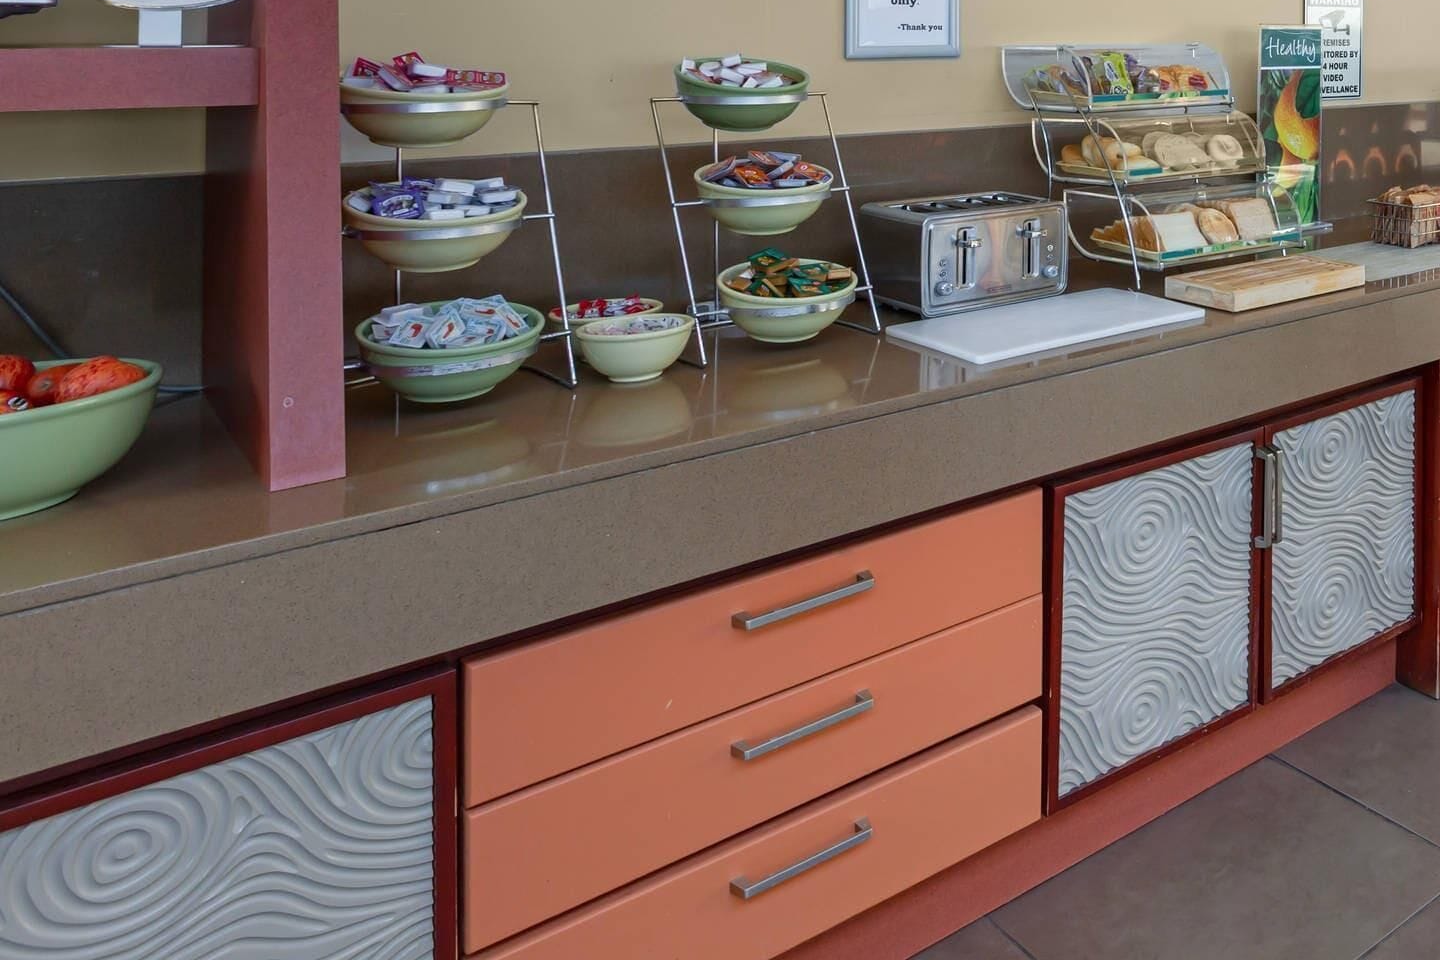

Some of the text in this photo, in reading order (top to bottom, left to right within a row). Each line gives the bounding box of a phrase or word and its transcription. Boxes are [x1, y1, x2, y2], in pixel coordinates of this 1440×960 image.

[928, 24, 943, 32] you
[1265, 36, 1316, 63] Healthy
[1349, 50, 1359, 58] BY
[1328, 62, 1348, 71] HOUR
[1323, 74, 1344, 82] VIDEO
[1321, 85, 1358, 94] VEILLANCE
